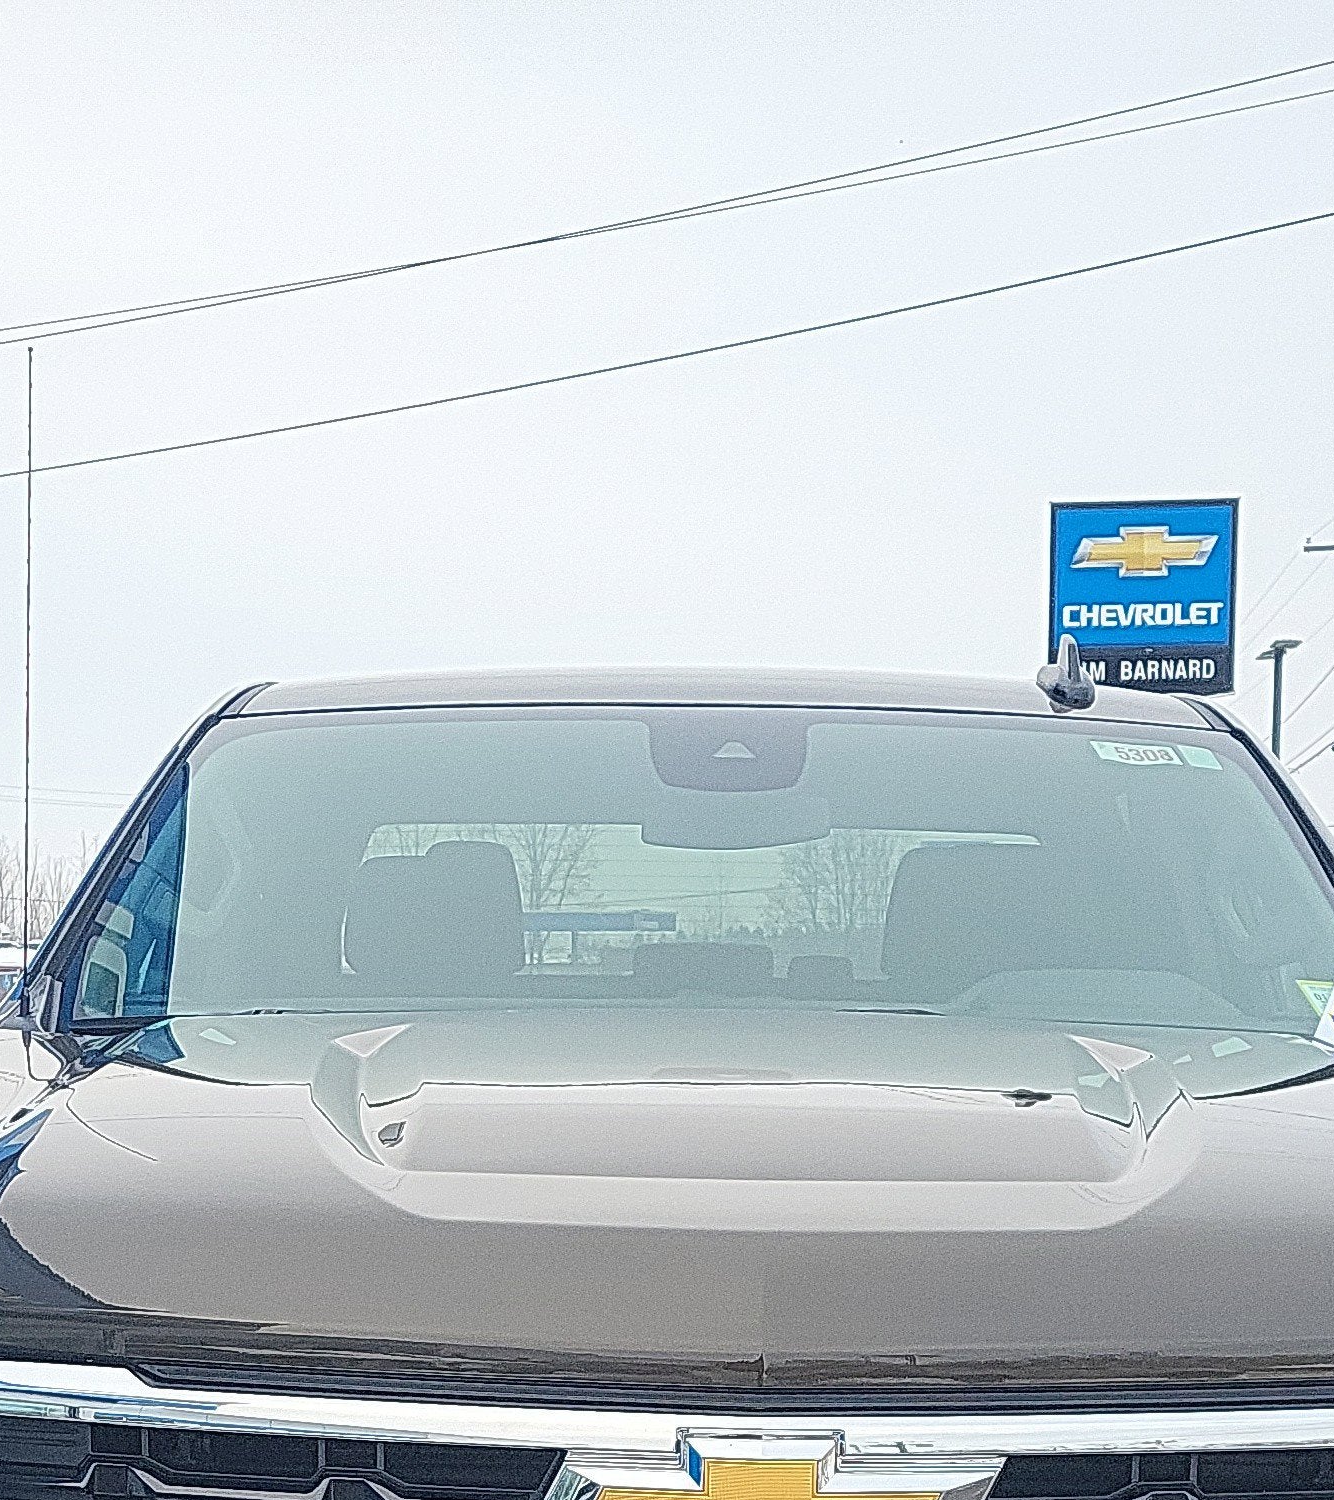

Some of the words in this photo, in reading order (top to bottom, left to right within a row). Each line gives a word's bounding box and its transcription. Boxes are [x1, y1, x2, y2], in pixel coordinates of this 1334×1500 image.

[1062, 602, 1224, 628] CHEVROLET
[1082, 660, 1106, 682] IM
[1120, 658, 1216, 681] BARNARD
[1113, 746, 1174, 762] 5308
